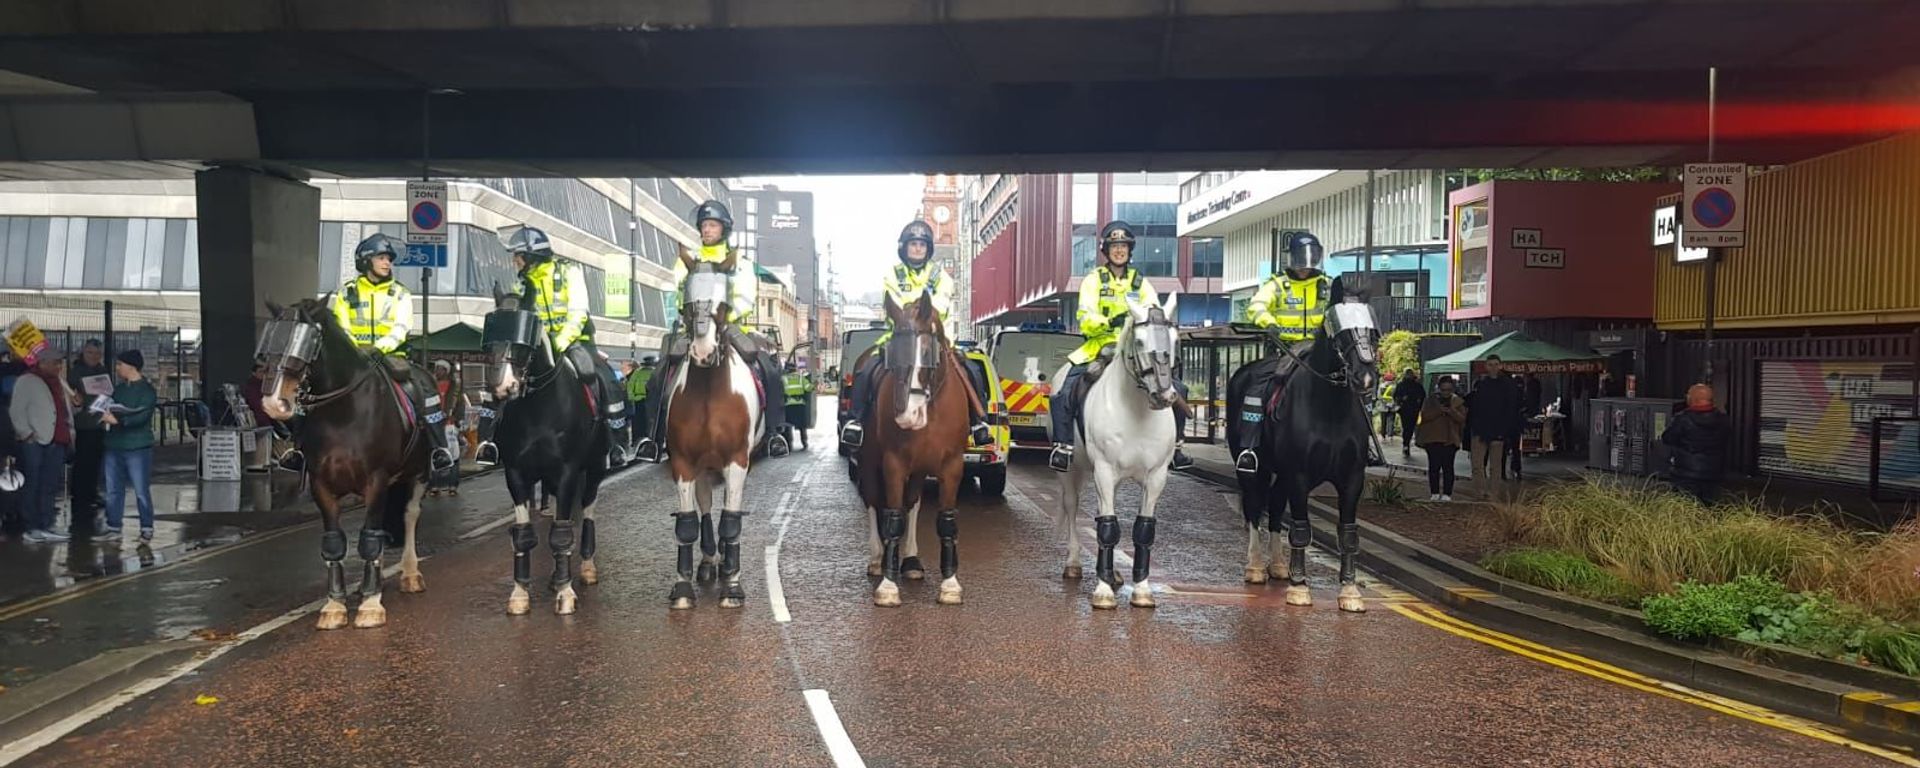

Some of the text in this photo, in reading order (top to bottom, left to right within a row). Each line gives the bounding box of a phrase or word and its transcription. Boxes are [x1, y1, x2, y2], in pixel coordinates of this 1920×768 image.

[1688, 165, 1742, 174] Controlled
[1696, 175, 1733, 185] ZONE
[415, 191, 438, 199] ZONE
[1657, 216, 1675, 237] HA
[1516, 233, 1537, 244] HA
[1529, 252, 1560, 264] TCH
[1527, 362, 1567, 373] Workers
